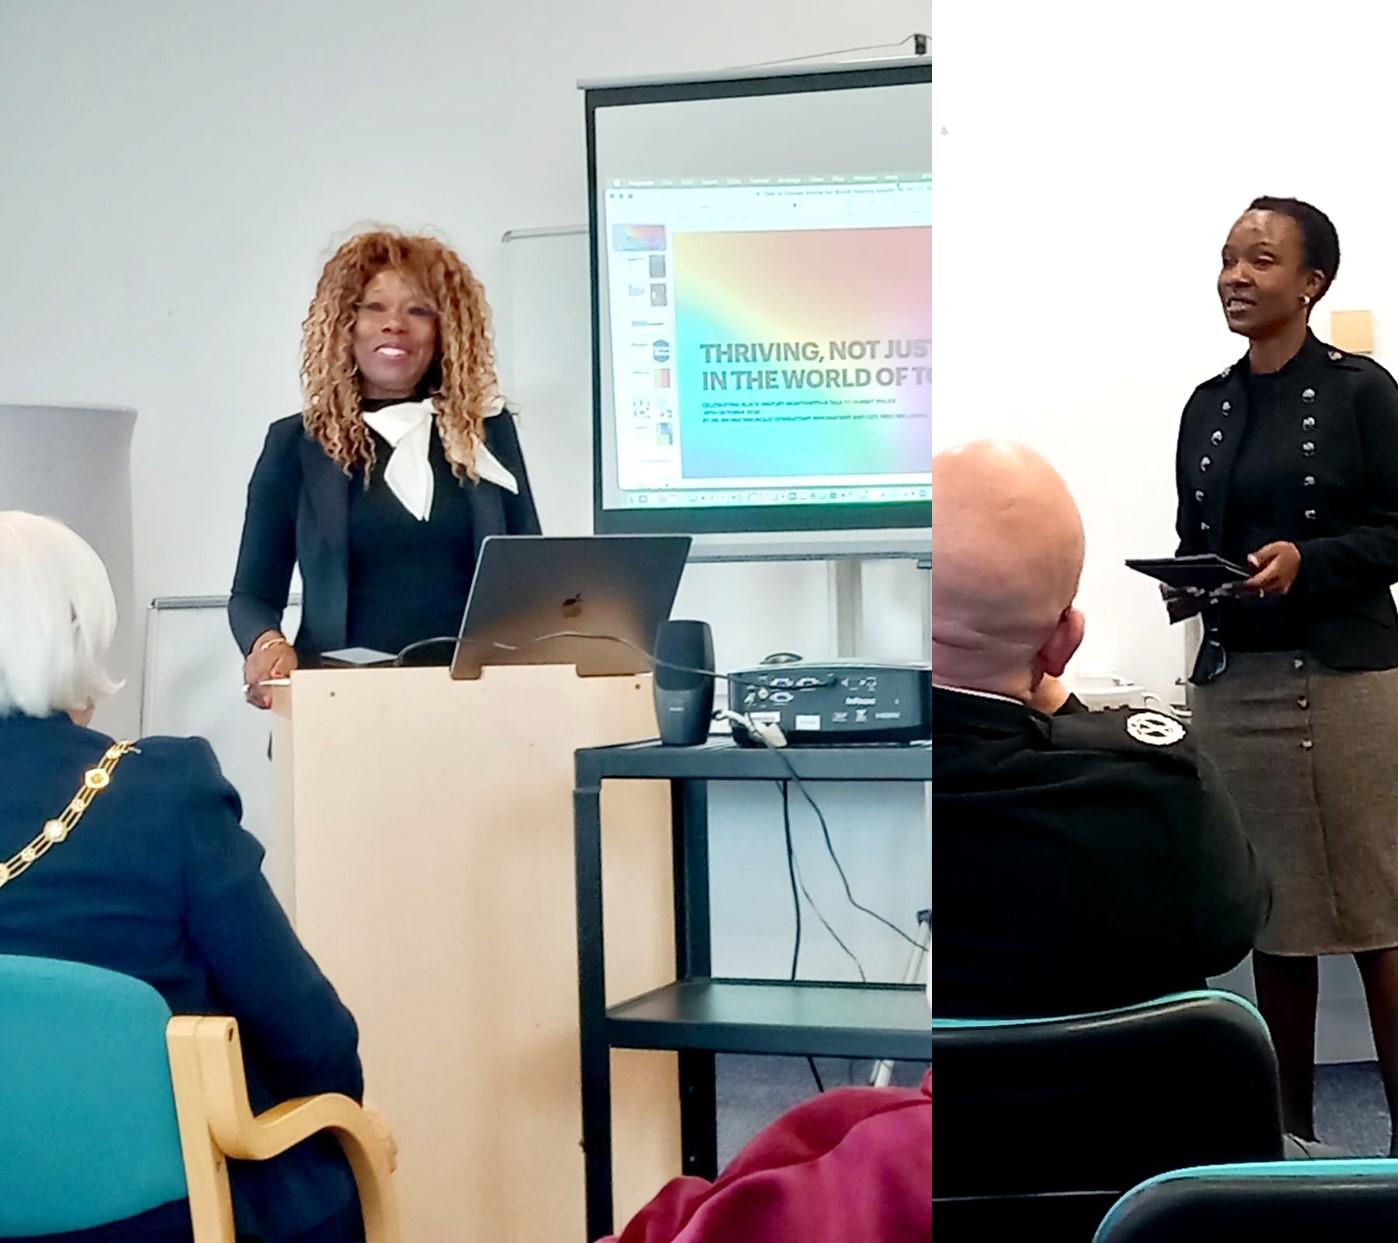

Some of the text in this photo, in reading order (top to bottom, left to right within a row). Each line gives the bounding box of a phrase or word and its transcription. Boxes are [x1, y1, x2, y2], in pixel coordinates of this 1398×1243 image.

[700, 341, 824, 363] THRIVING,
[829, 340, 880, 361] NOT
[702, 371, 727, 390] IN
[731, 370, 779, 390] THE
[782, 368, 872, 389] WORLD
[876, 367, 908, 387] OF
